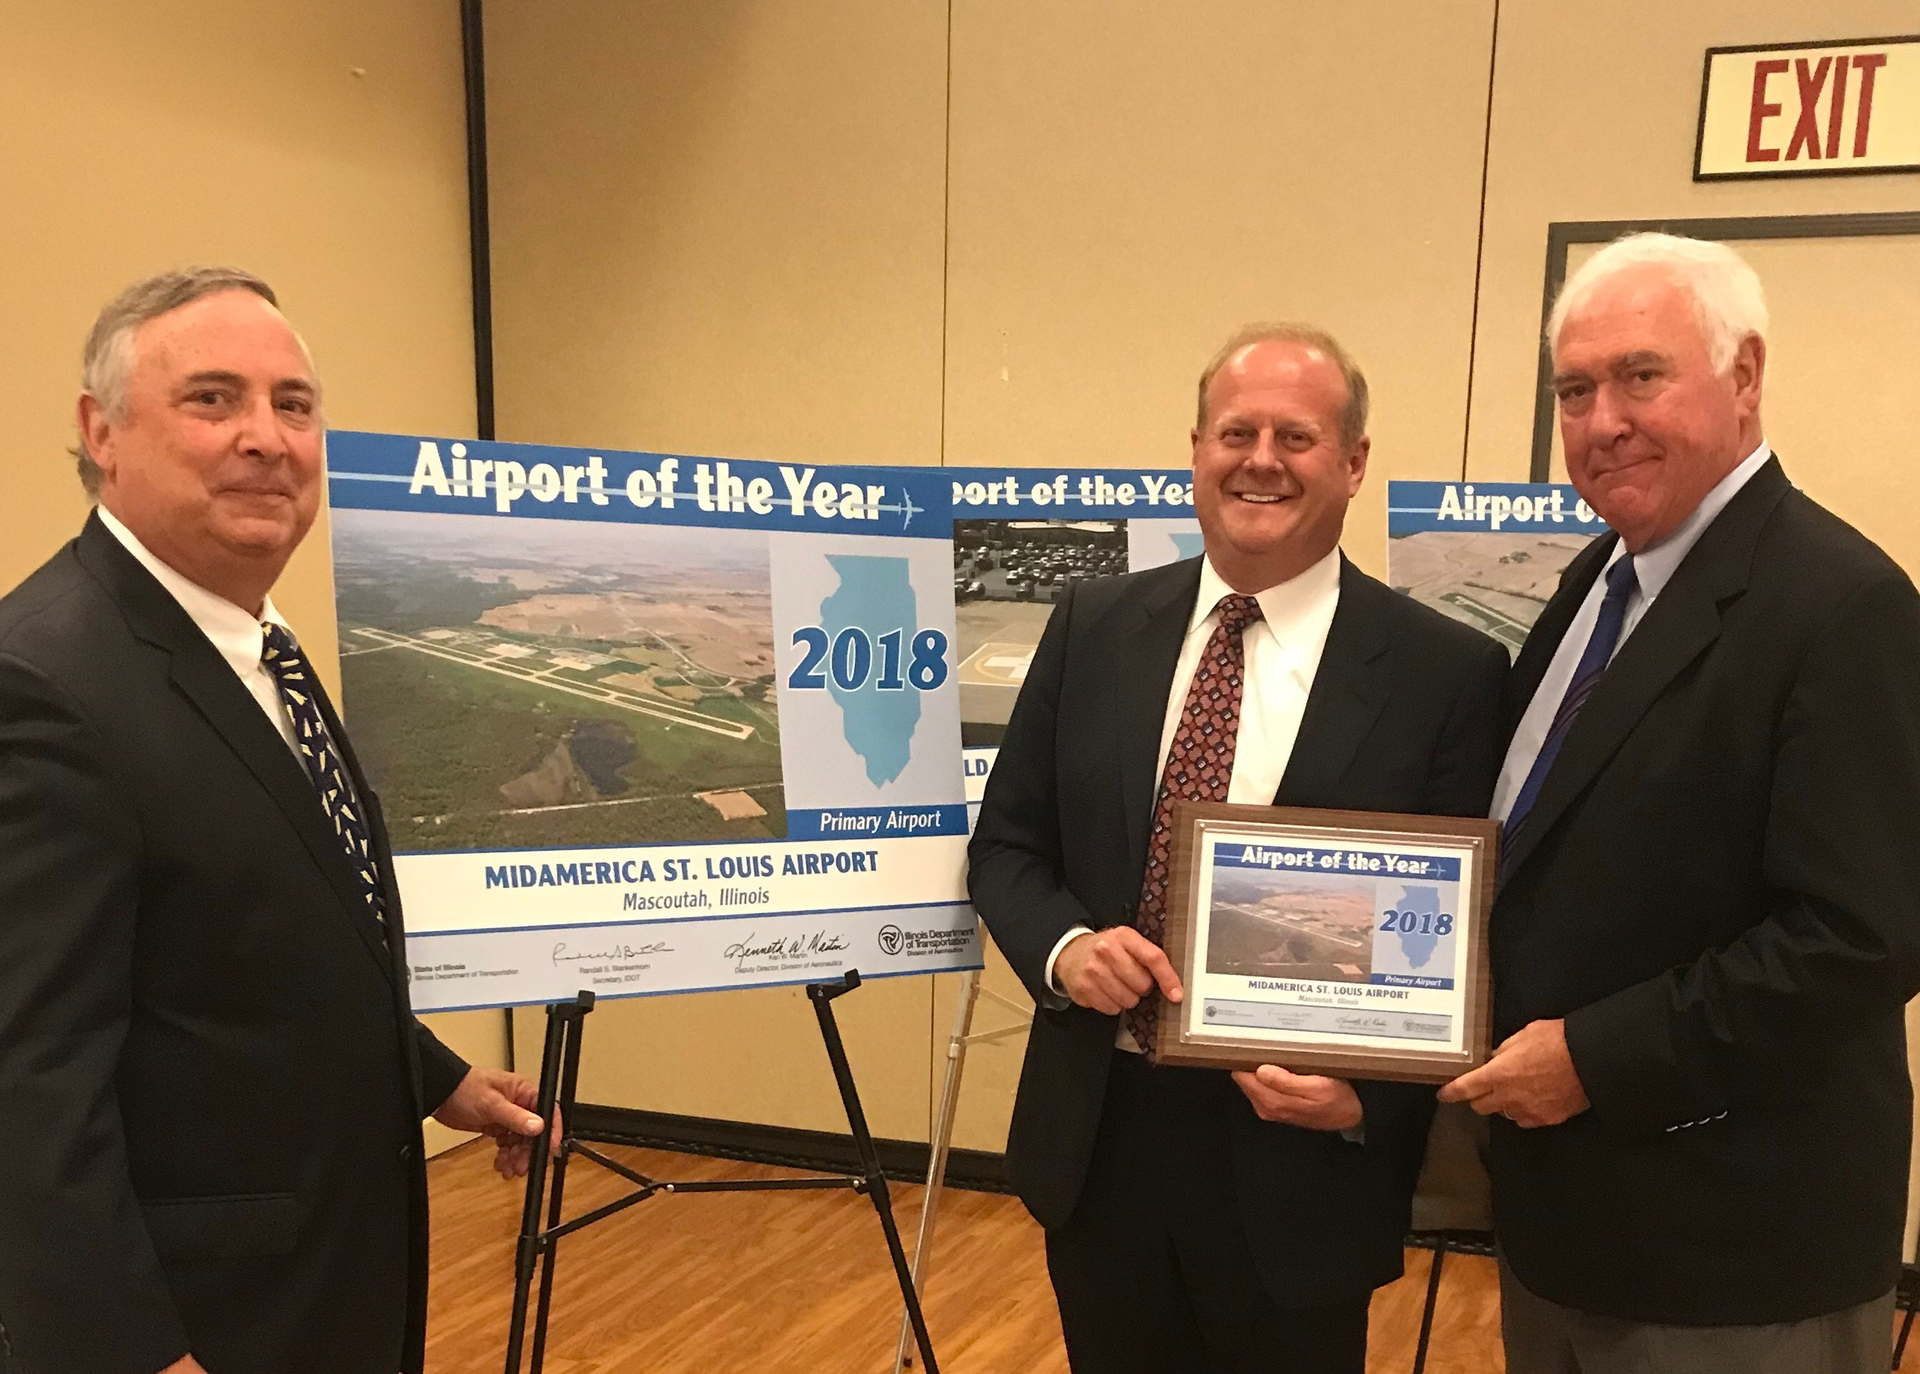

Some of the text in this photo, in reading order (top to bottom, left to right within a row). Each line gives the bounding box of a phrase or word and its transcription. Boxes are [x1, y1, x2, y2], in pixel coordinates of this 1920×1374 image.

[1745, 53, 1887, 163] EXIT
[408, 440, 885, 520] Airport of the Year
[1031, 475, 1068, 505] of
[1079, 475, 1136, 506] the
[1437, 485, 1606, 530] Airport o
[788, 626, 949, 692] 2018
[820, 810, 941, 833] Primary Airport
[485, 850, 879, 889] MIDAMERICA ST. LOUIS AIRPORT
[1241, 846, 1430, 875] Airport of the Year
[623, 886, 770, 911] Mascoutah, Illinois
[905, 928, 975, 940] Illinois Department
[1379, 909, 1454, 936] 2018
[906, 937, 970, 949] of Transportation
[1248, 980, 1410, 1000] MIDAMERICA ST. LOUIS AIRPORT
[1385, 975, 1442, 987] Primary Airport
